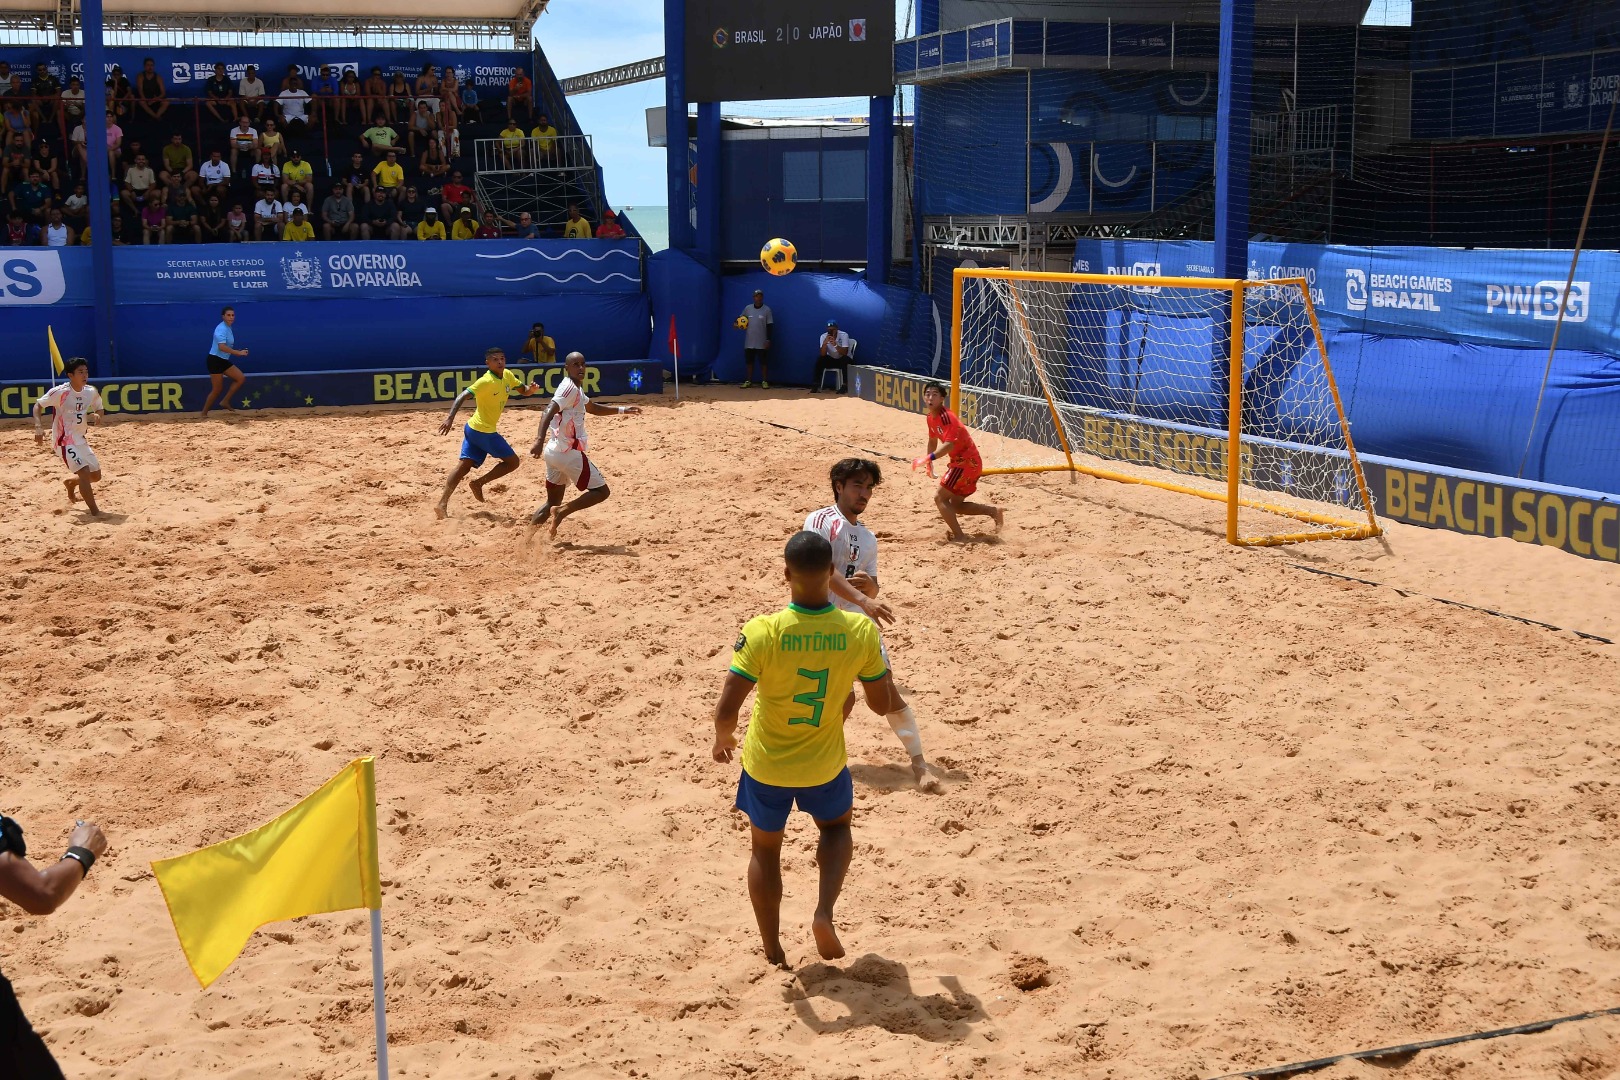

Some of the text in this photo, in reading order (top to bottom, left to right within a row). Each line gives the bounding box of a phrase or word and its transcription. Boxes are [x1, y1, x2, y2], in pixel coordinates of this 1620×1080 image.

[735, 22, 842, 44] BRASIL 2 0 JAPÃO
[194, 63, 215, 71] BEAC
[194, 71, 249, 80] BRZIL
[475, 77, 488, 86] DA
[167, 260, 217, 268] SECRETARIA
[219, 259, 230, 267] DE
[328, 254, 407, 270] GOVERNO
[1186, 264, 1215, 274] SECRETARIA D
[172, 271, 227, 279] JUVENTUDE,
[228, 270, 267, 278] ESPORTE
[330, 269, 422, 288] DA PARAÍBA
[1269, 265, 1316, 285] GOVERNO
[1370, 273, 1453, 293] BEACH GAMES
[241, 281, 269, 289] LAZER
[1371, 290, 1441, 312] BRAZIL
[1486, 282, 1585, 319] PWBG
[373, 371, 478, 402] BEACH
[875, 373, 920, 413] BEACH
[0, 382, 184, 415] CH CCER
[76, 413, 83, 425] 5
[1084, 415, 1155, 463] BEACH
[67, 447, 77, 460] 5
[1385, 468, 1620, 562] BEACH SOCC
[849, 534, 858, 542] Y-3
[781, 631, 847, 651] ANTÔNIO
[788, 668, 829, 728] 3
